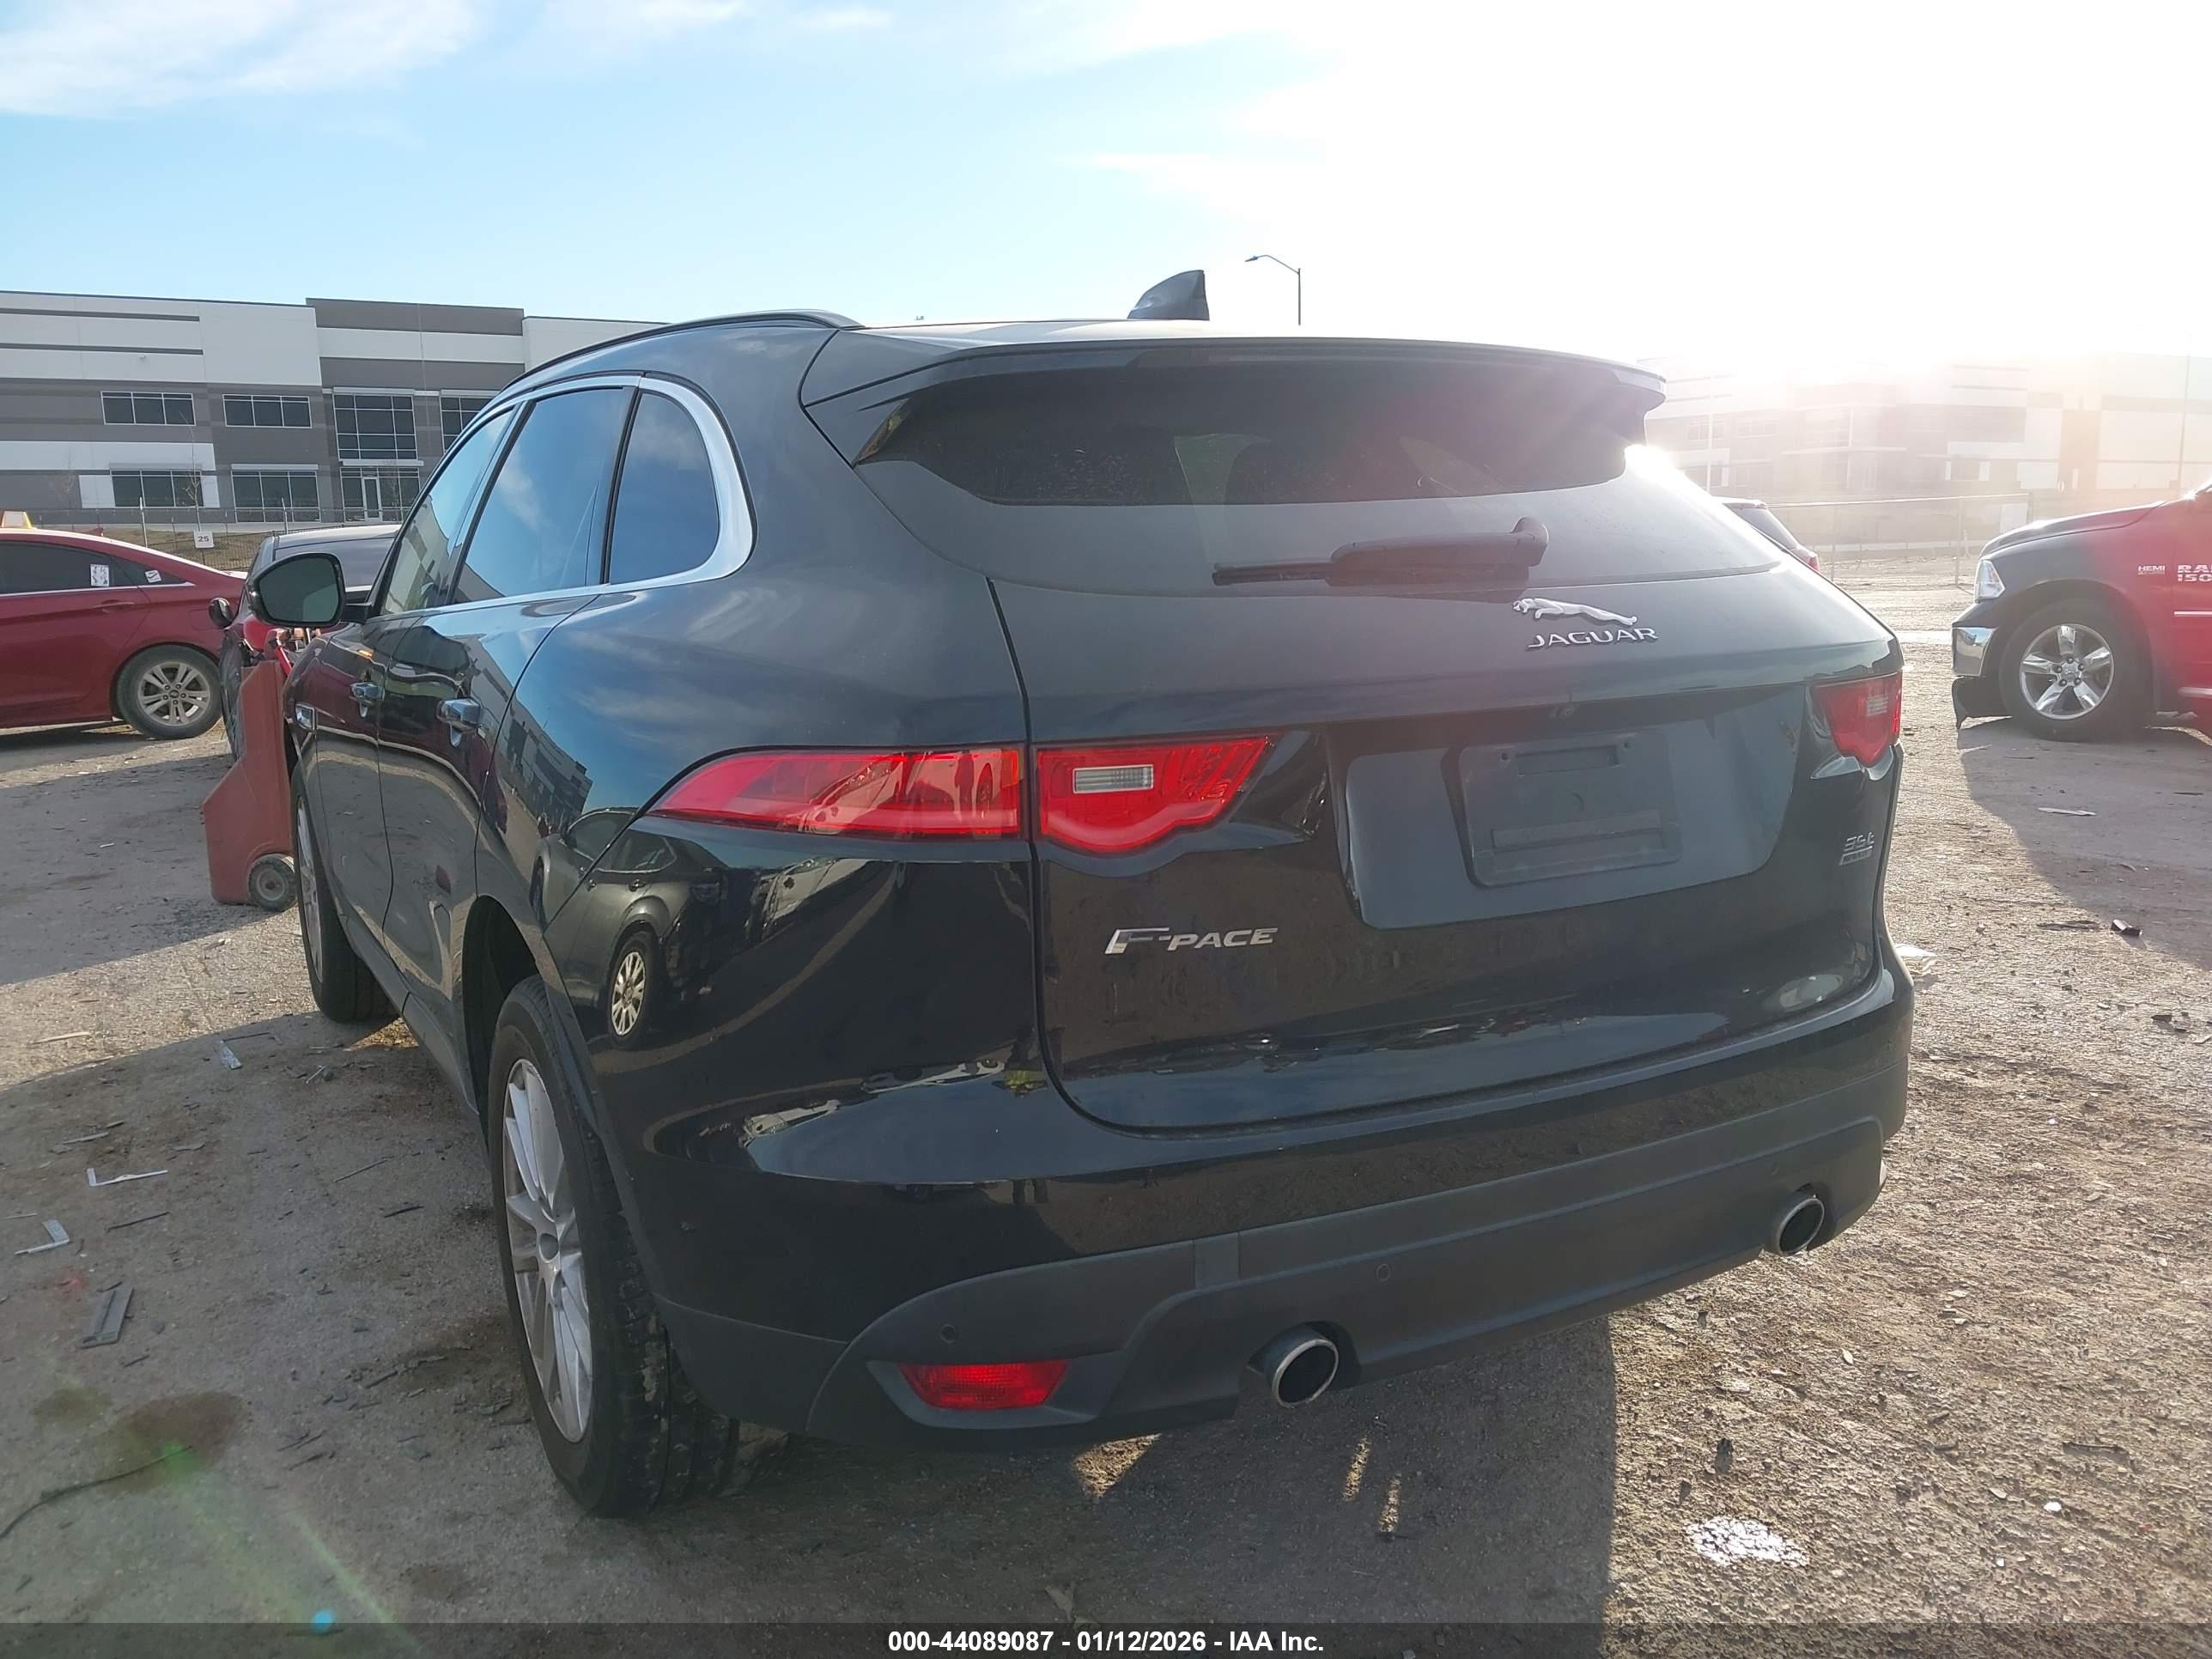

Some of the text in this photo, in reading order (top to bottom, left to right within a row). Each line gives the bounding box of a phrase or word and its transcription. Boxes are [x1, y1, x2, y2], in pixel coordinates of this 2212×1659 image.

[2177, 564, 2212, 574] RA
[1528, 628, 1658, 648] JAGUAR
[1104, 927, 1279, 955] F-PACE
